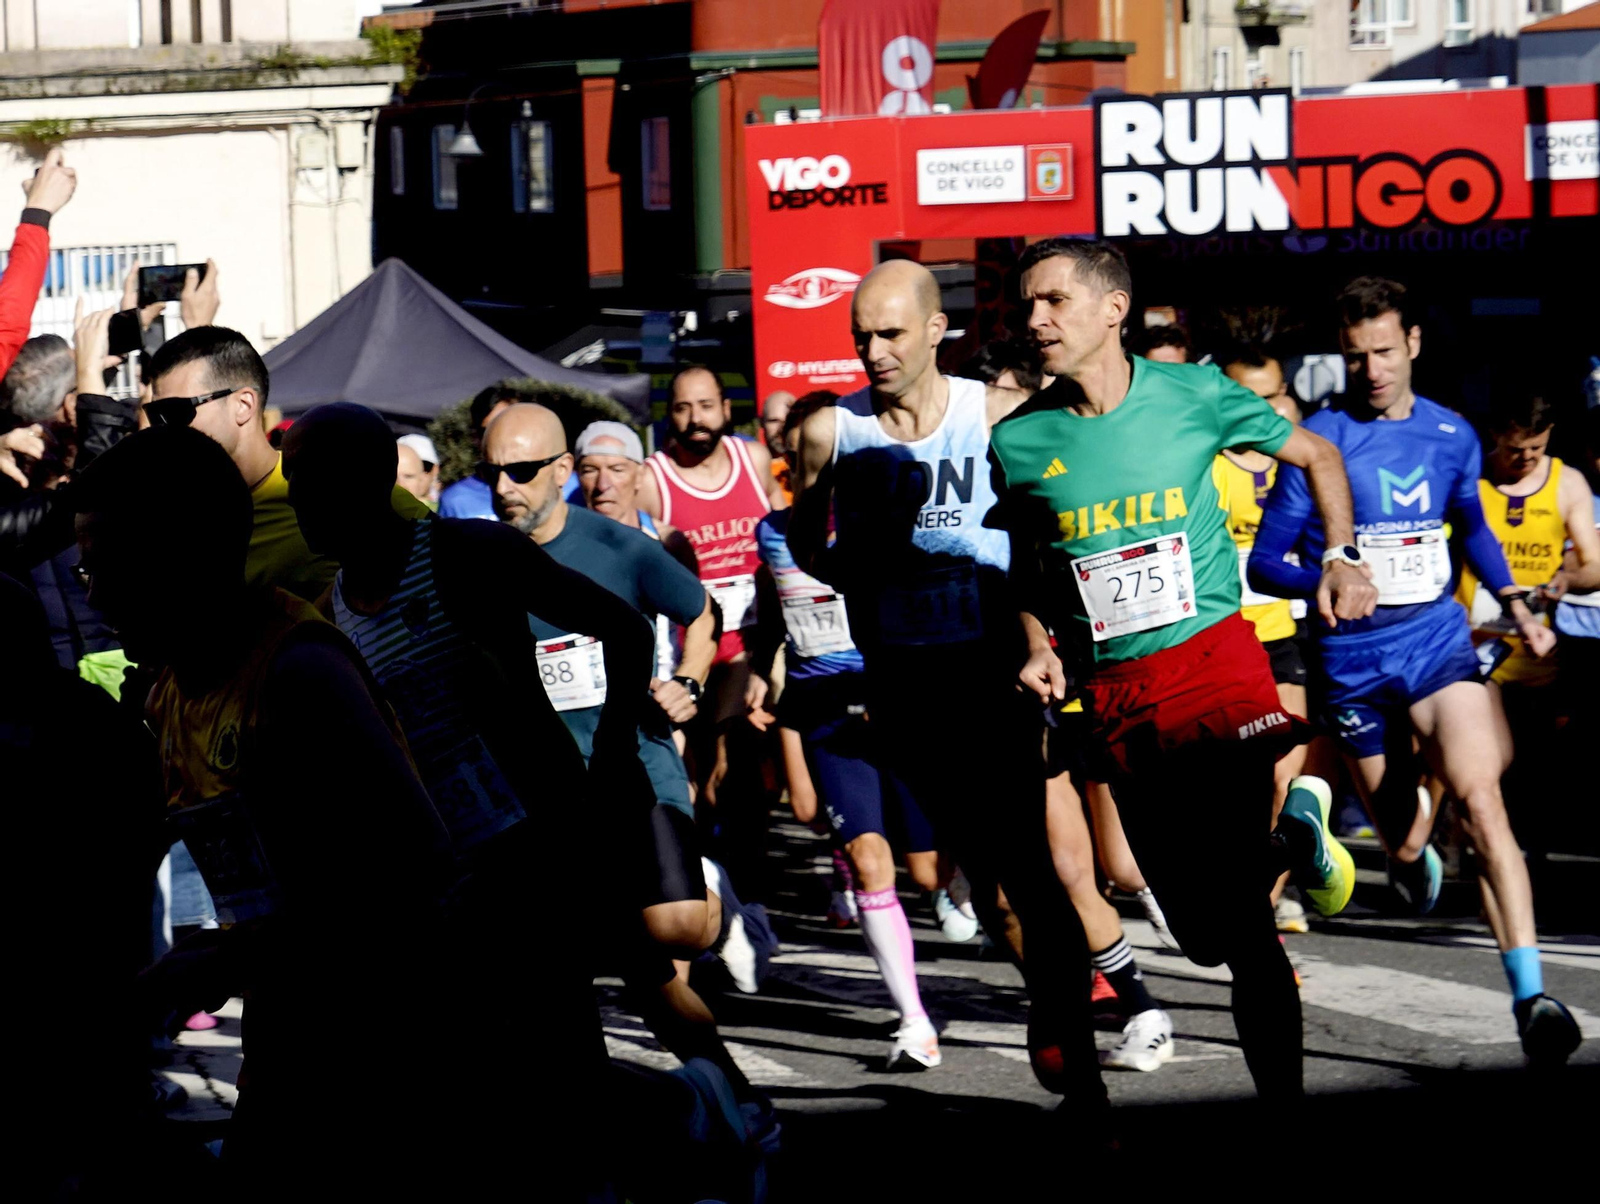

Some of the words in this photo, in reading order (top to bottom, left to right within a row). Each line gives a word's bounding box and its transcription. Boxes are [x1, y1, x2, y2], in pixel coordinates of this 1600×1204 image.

[1100, 94, 1288, 167] RUN
[758, 154, 852, 191] VIGO
[926, 158, 1015, 175] CONCELLO
[937, 178, 960, 192] DE
[964, 175, 1005, 191] VIGO
[768, 182, 889, 211] DEPORTE
[797, 358, 866, 376] HYUNDA
[914, 509, 962, 529] NERS
[1057, 486, 1189, 542] BIKILA
[1500, 541, 1552, 558] INOS
[1387, 554, 1425, 578] 148
[1106, 565, 1165, 604] 275
[540, 660, 575, 686] 88
